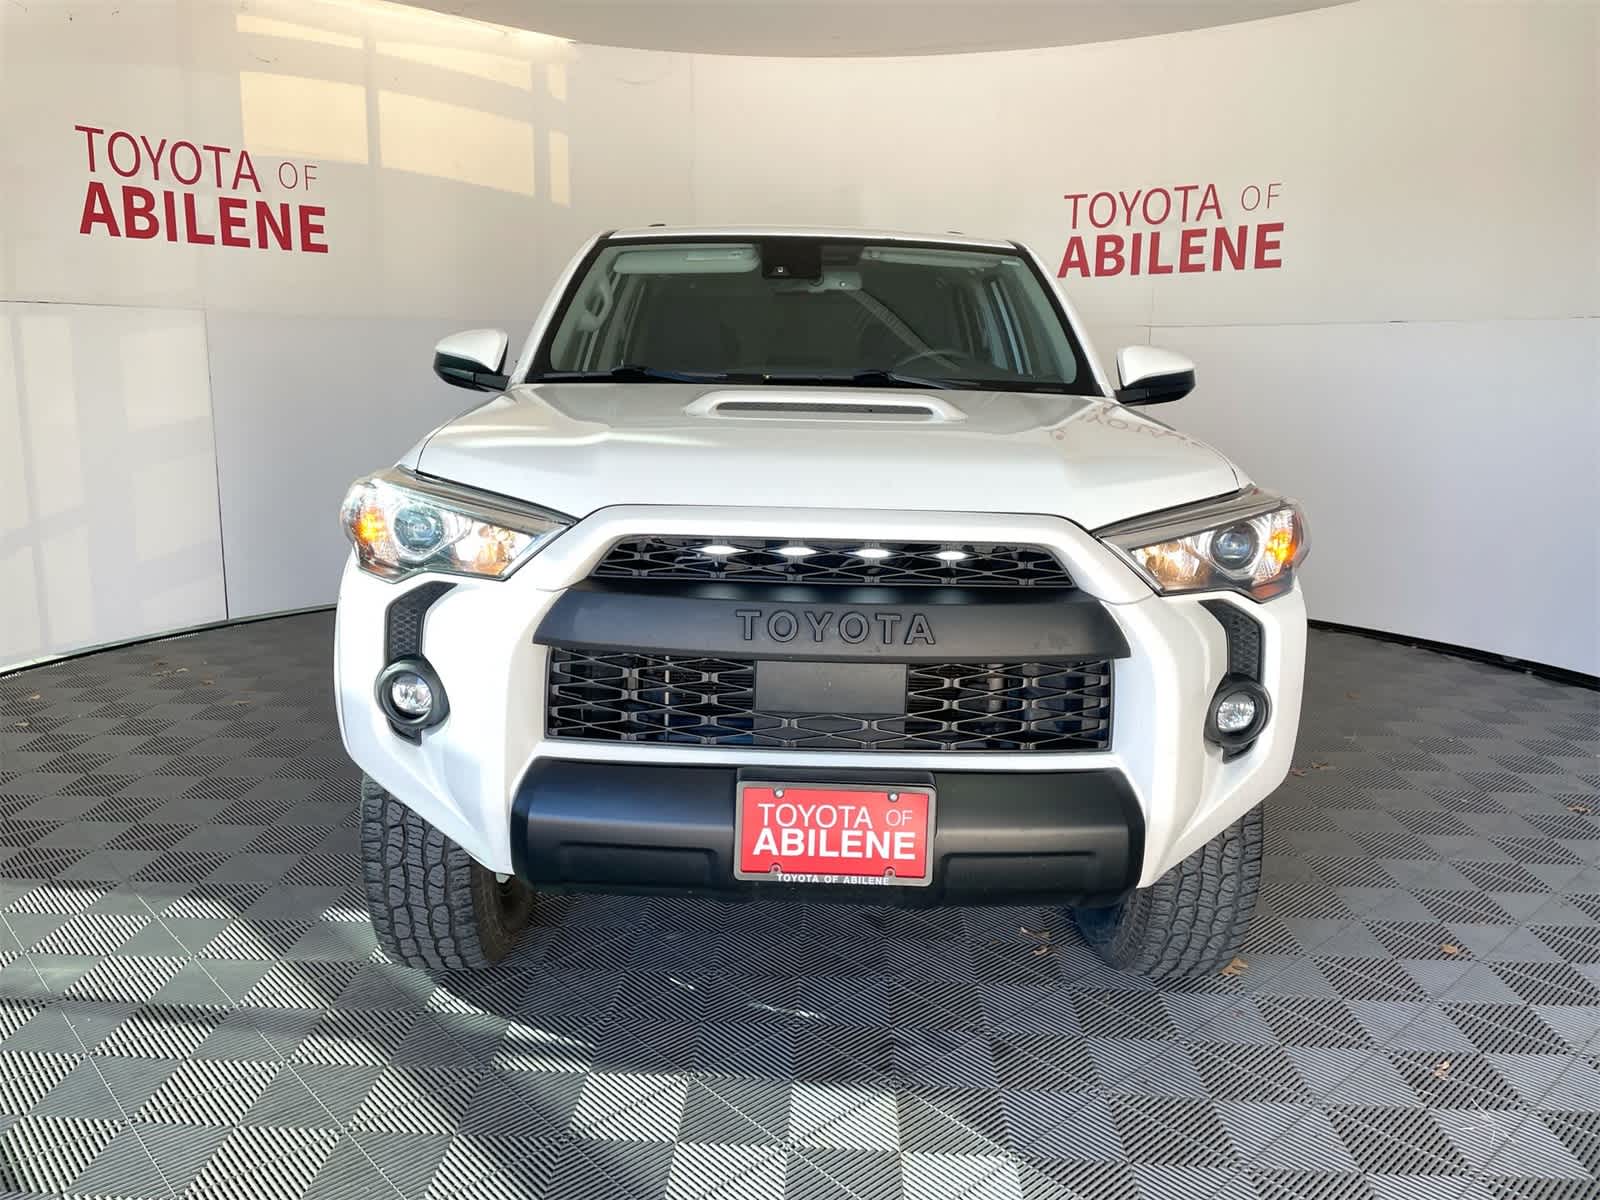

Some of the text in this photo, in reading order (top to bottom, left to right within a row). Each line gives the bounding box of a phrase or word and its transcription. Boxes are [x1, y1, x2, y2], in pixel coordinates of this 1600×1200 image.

[75, 125, 318, 192] TOYOTA OF
[80, 181, 329, 253] ABILENE
[1064, 183, 1283, 229] TOYOTA OF
[1056, 222, 1284, 279] ABILENE
[735, 608, 936, 645] TOYOTA
[758, 803, 913, 829] TOYOTA OF
[752, 827, 916, 860] ABILENE
[776, 874, 890, 886] TOYOTA OF ABILENE
